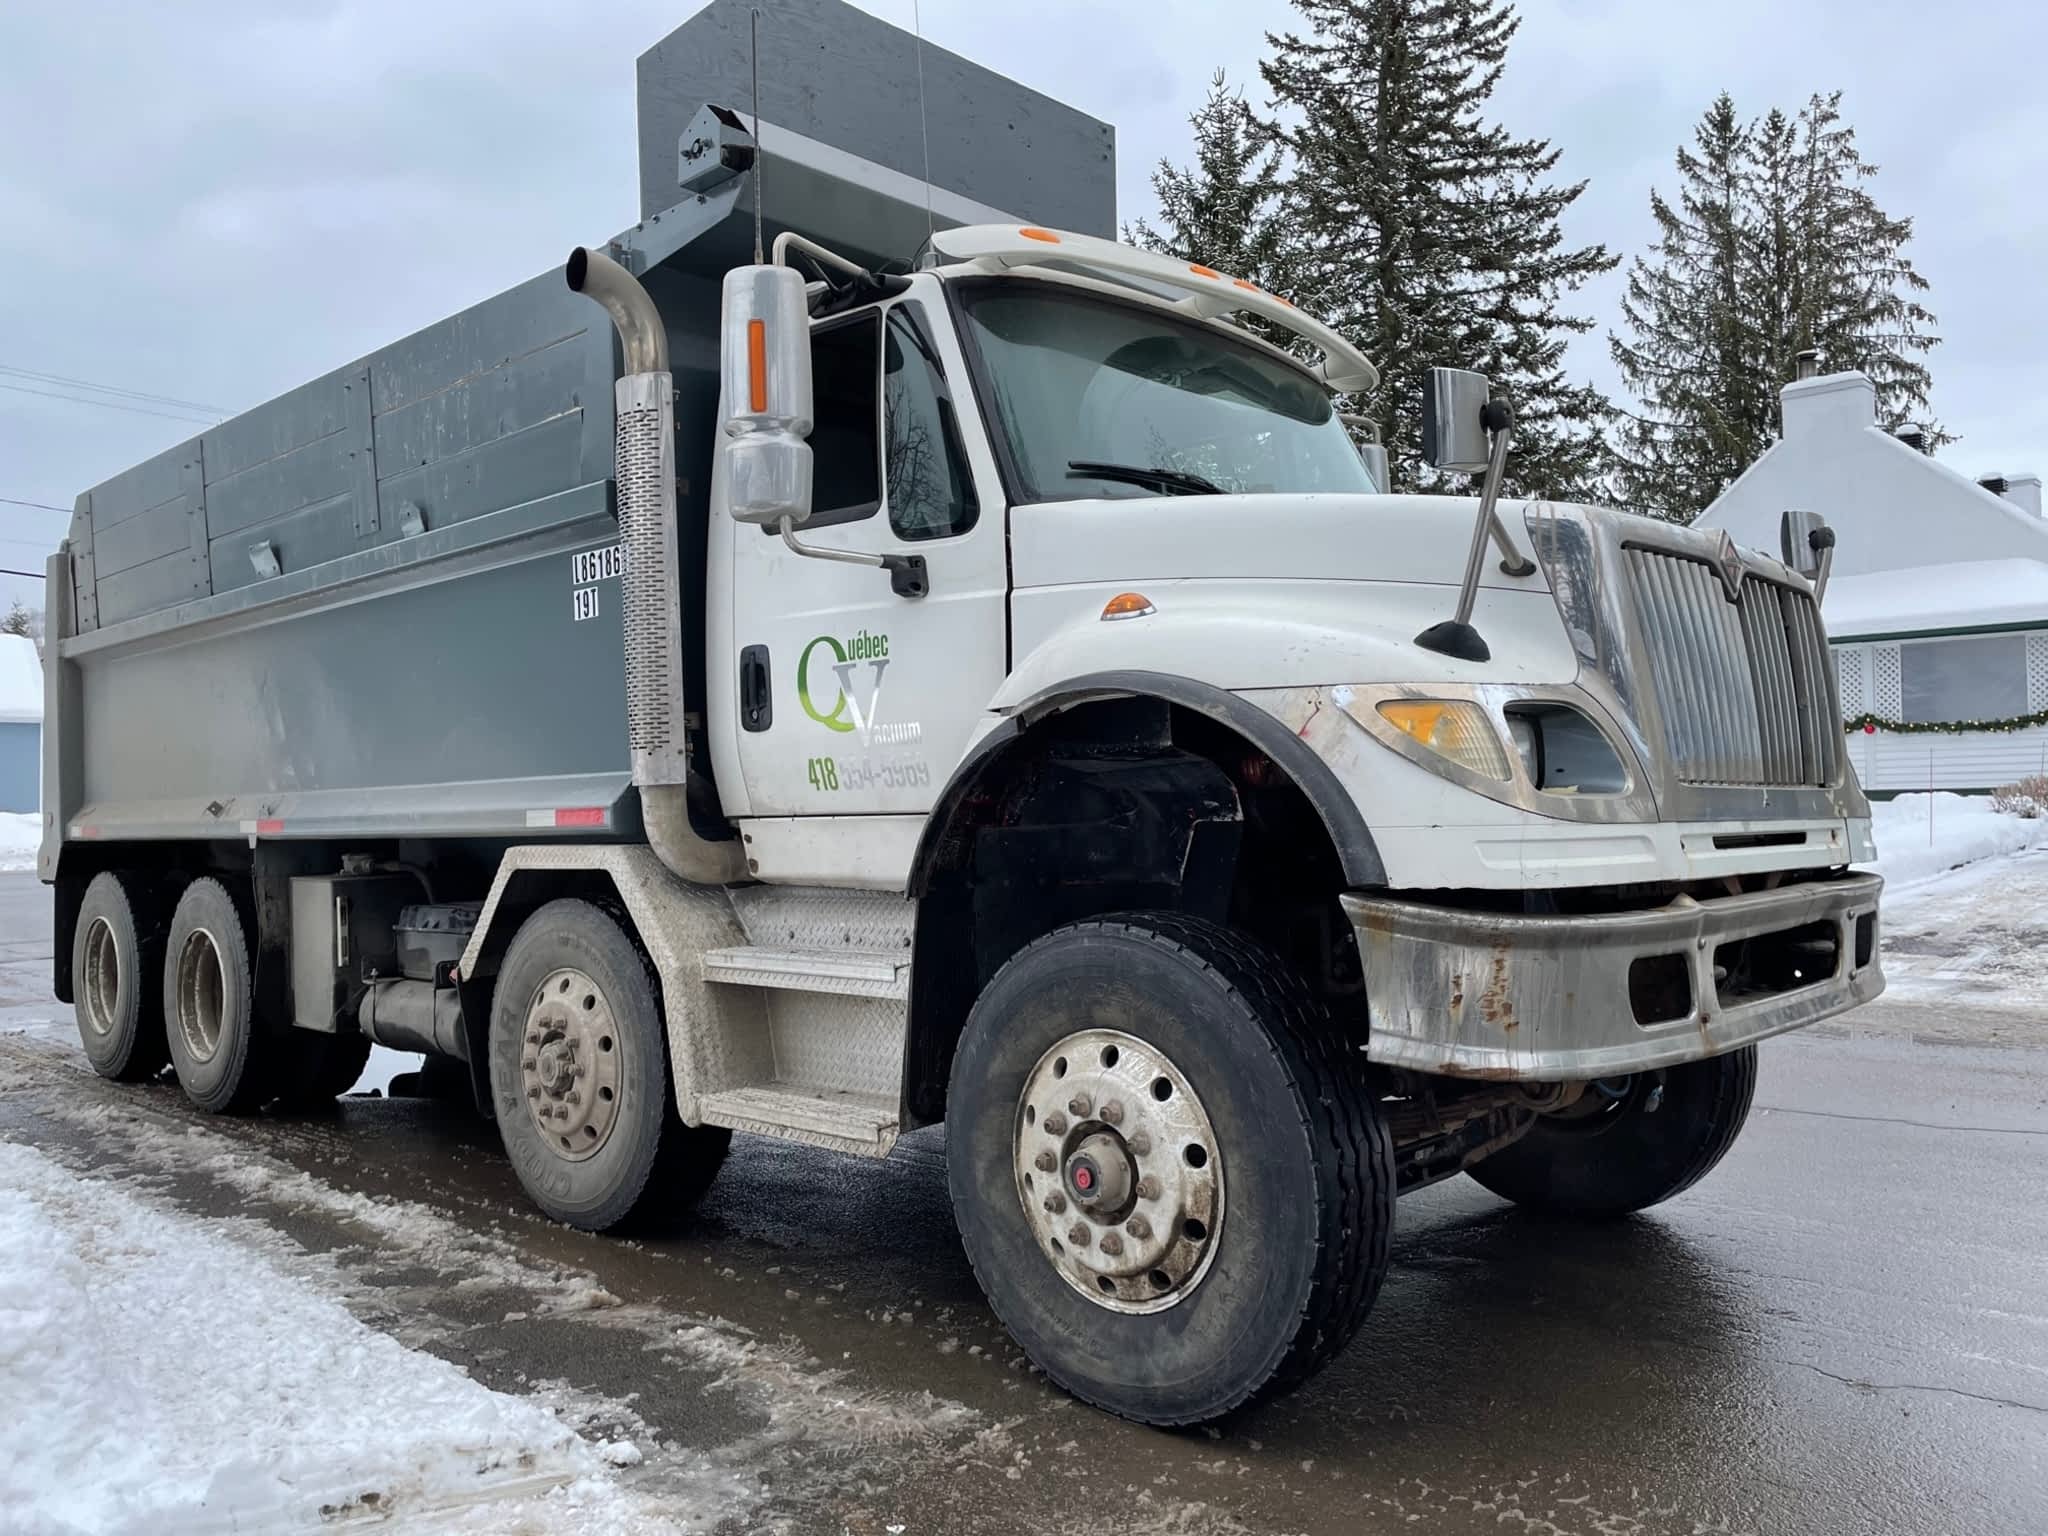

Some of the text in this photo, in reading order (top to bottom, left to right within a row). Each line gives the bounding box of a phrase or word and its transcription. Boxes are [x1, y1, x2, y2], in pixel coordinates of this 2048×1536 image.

[574, 546, 620, 584] L86186
[575, 588, 597, 619] 19T
[797, 629, 888, 732] Québec
[832, 658, 922, 747] Vacuum
[808, 756, 839, 791] 418
